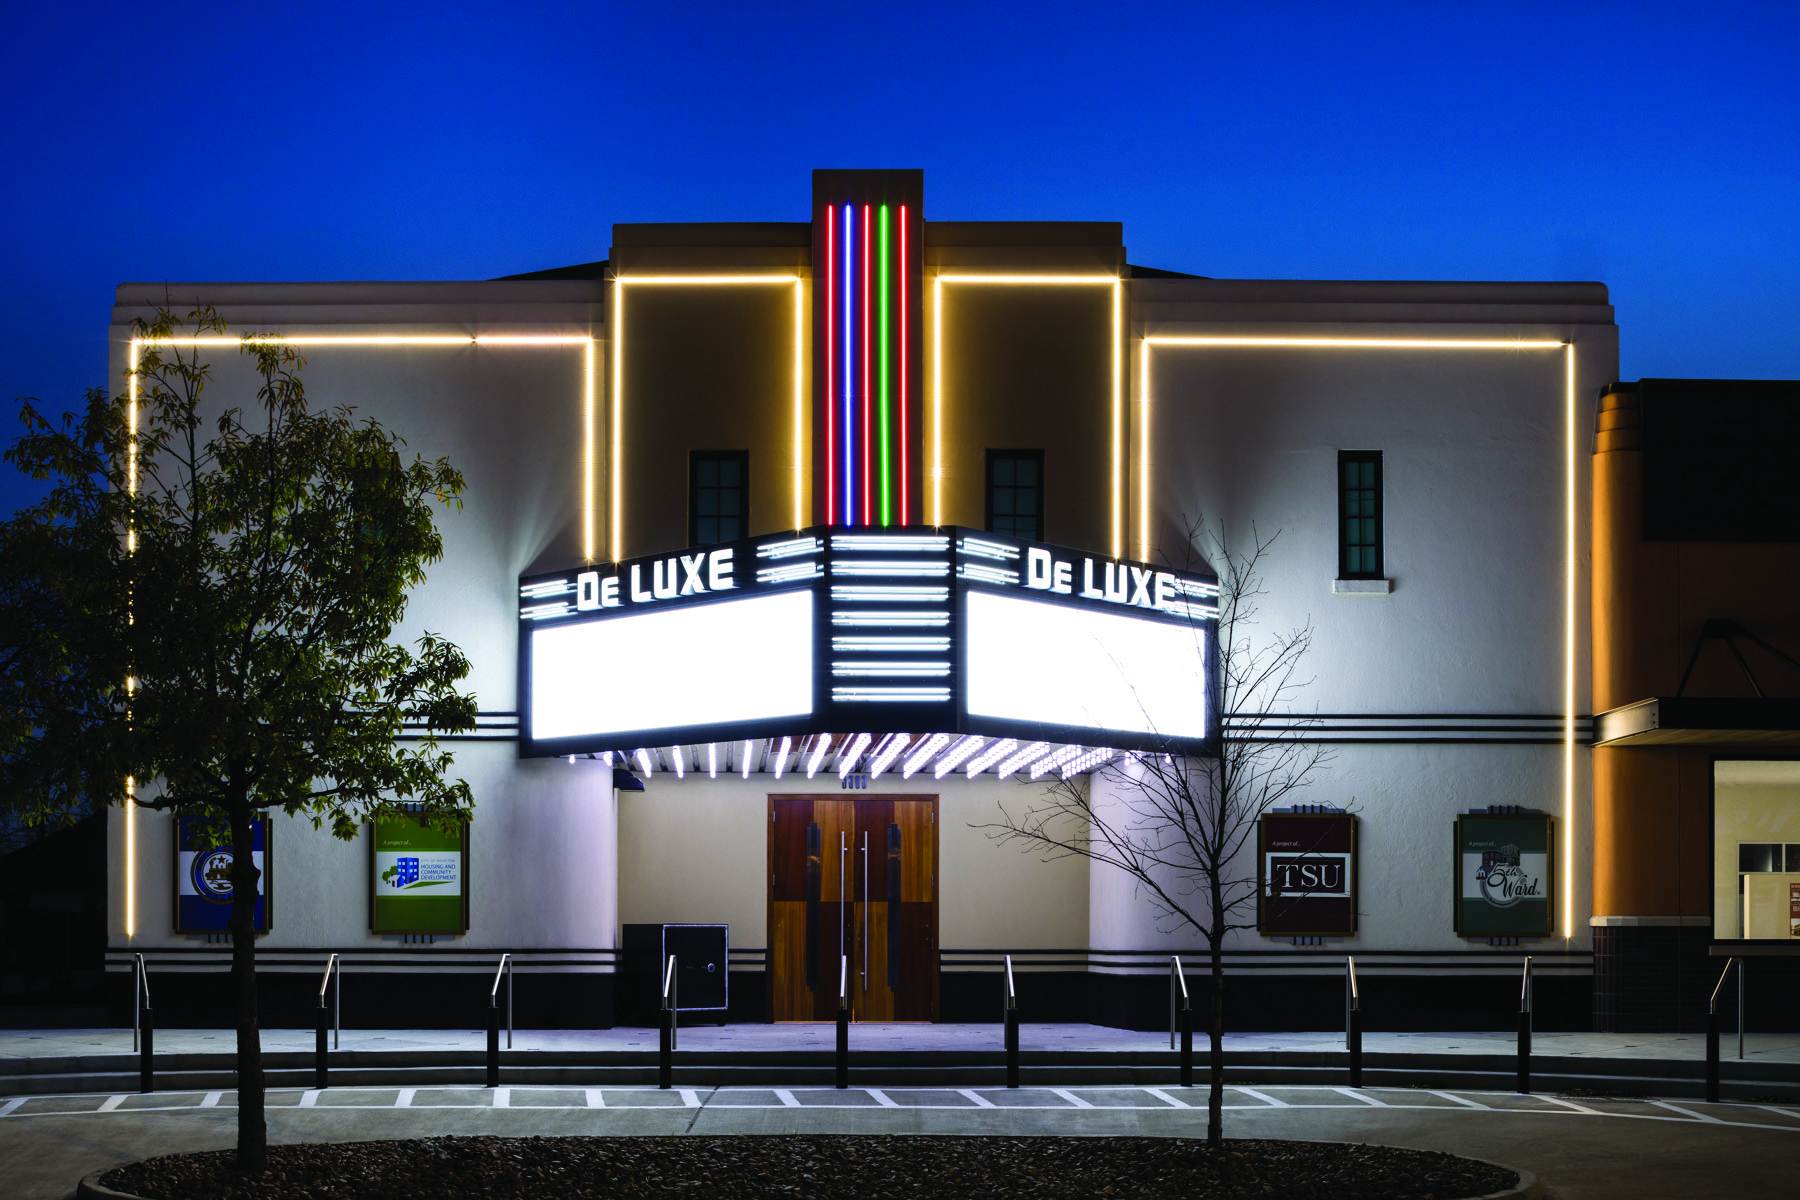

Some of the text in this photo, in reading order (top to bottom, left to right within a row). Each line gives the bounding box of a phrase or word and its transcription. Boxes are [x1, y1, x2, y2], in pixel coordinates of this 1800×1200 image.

[631, 548, 733, 603] LUXE
[1084, 558, 1176, 611] LUXE
[1276, 864, 1341, 888] TSU
[1487, 863, 1517, 887] 5th
[1502, 874, 1538, 898] Ward
